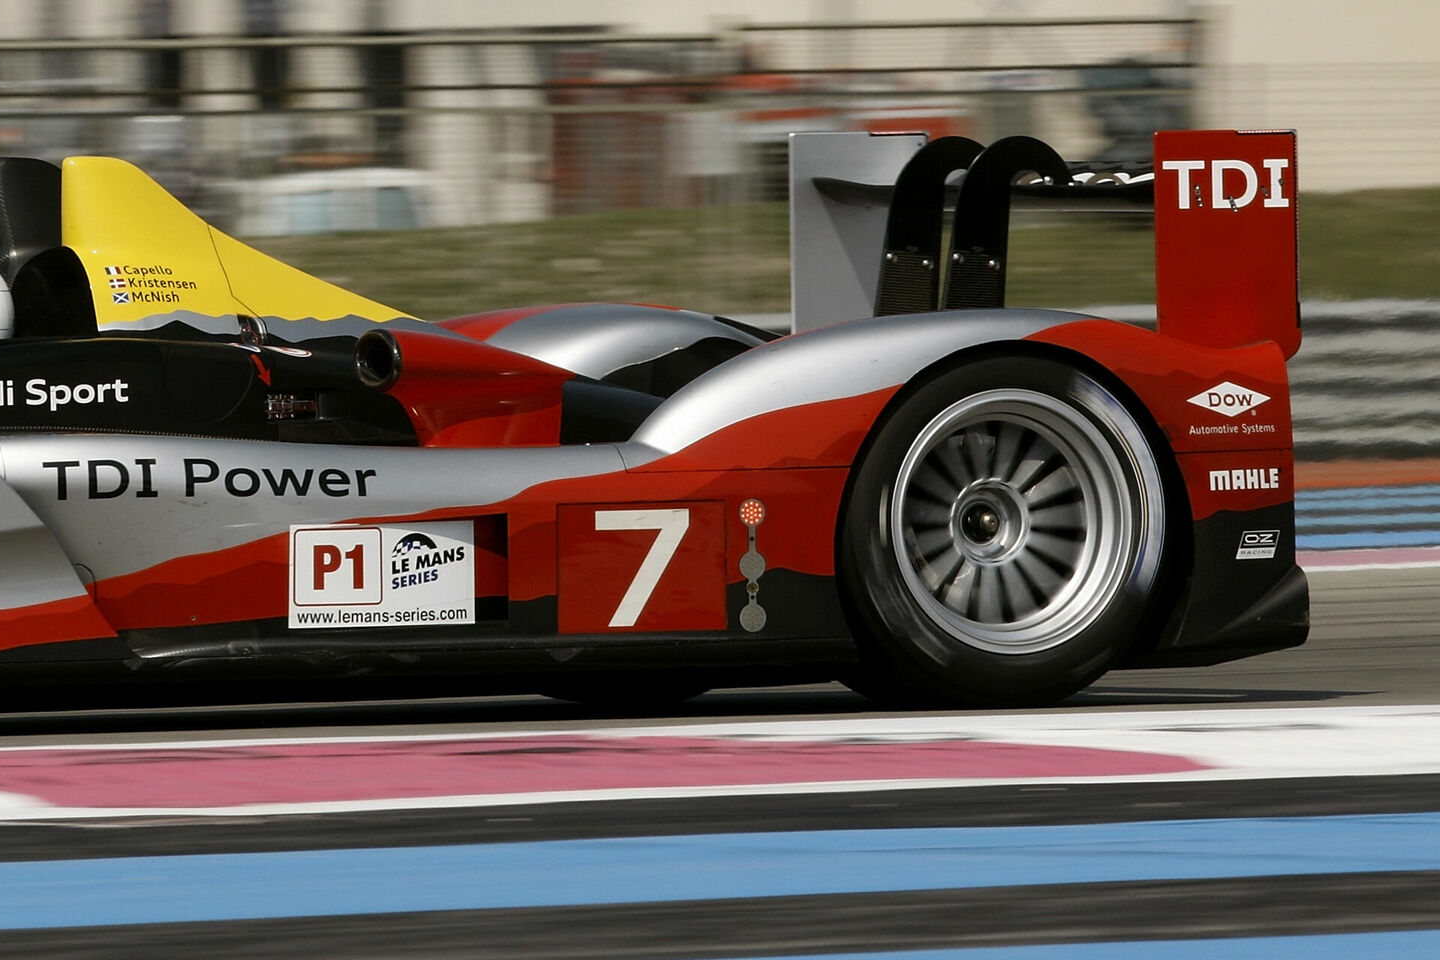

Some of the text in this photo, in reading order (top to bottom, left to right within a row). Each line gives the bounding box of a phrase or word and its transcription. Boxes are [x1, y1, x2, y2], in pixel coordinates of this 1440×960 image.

[1162, 158, 1289, 210] TDI
[123, 265, 173, 276] Capello
[128, 278, 197, 289] Kristensen
[132, 291, 180, 302] McNish
[25, 379, 129, 412] Sport
[1189, 423, 1275, 435] Automotive Systems
[42, 458, 376, 500] TDI Power
[1209, 468, 1279, 491] MAHLE
[1244, 533, 1274, 543] OZ
[313, 544, 364, 590] P1
[391, 546, 465, 575] LE MANS
[595, 508, 690, 627] 7
[391, 569, 439, 590] SERIES
[297, 607, 467, 624] www.lemans-series.com
